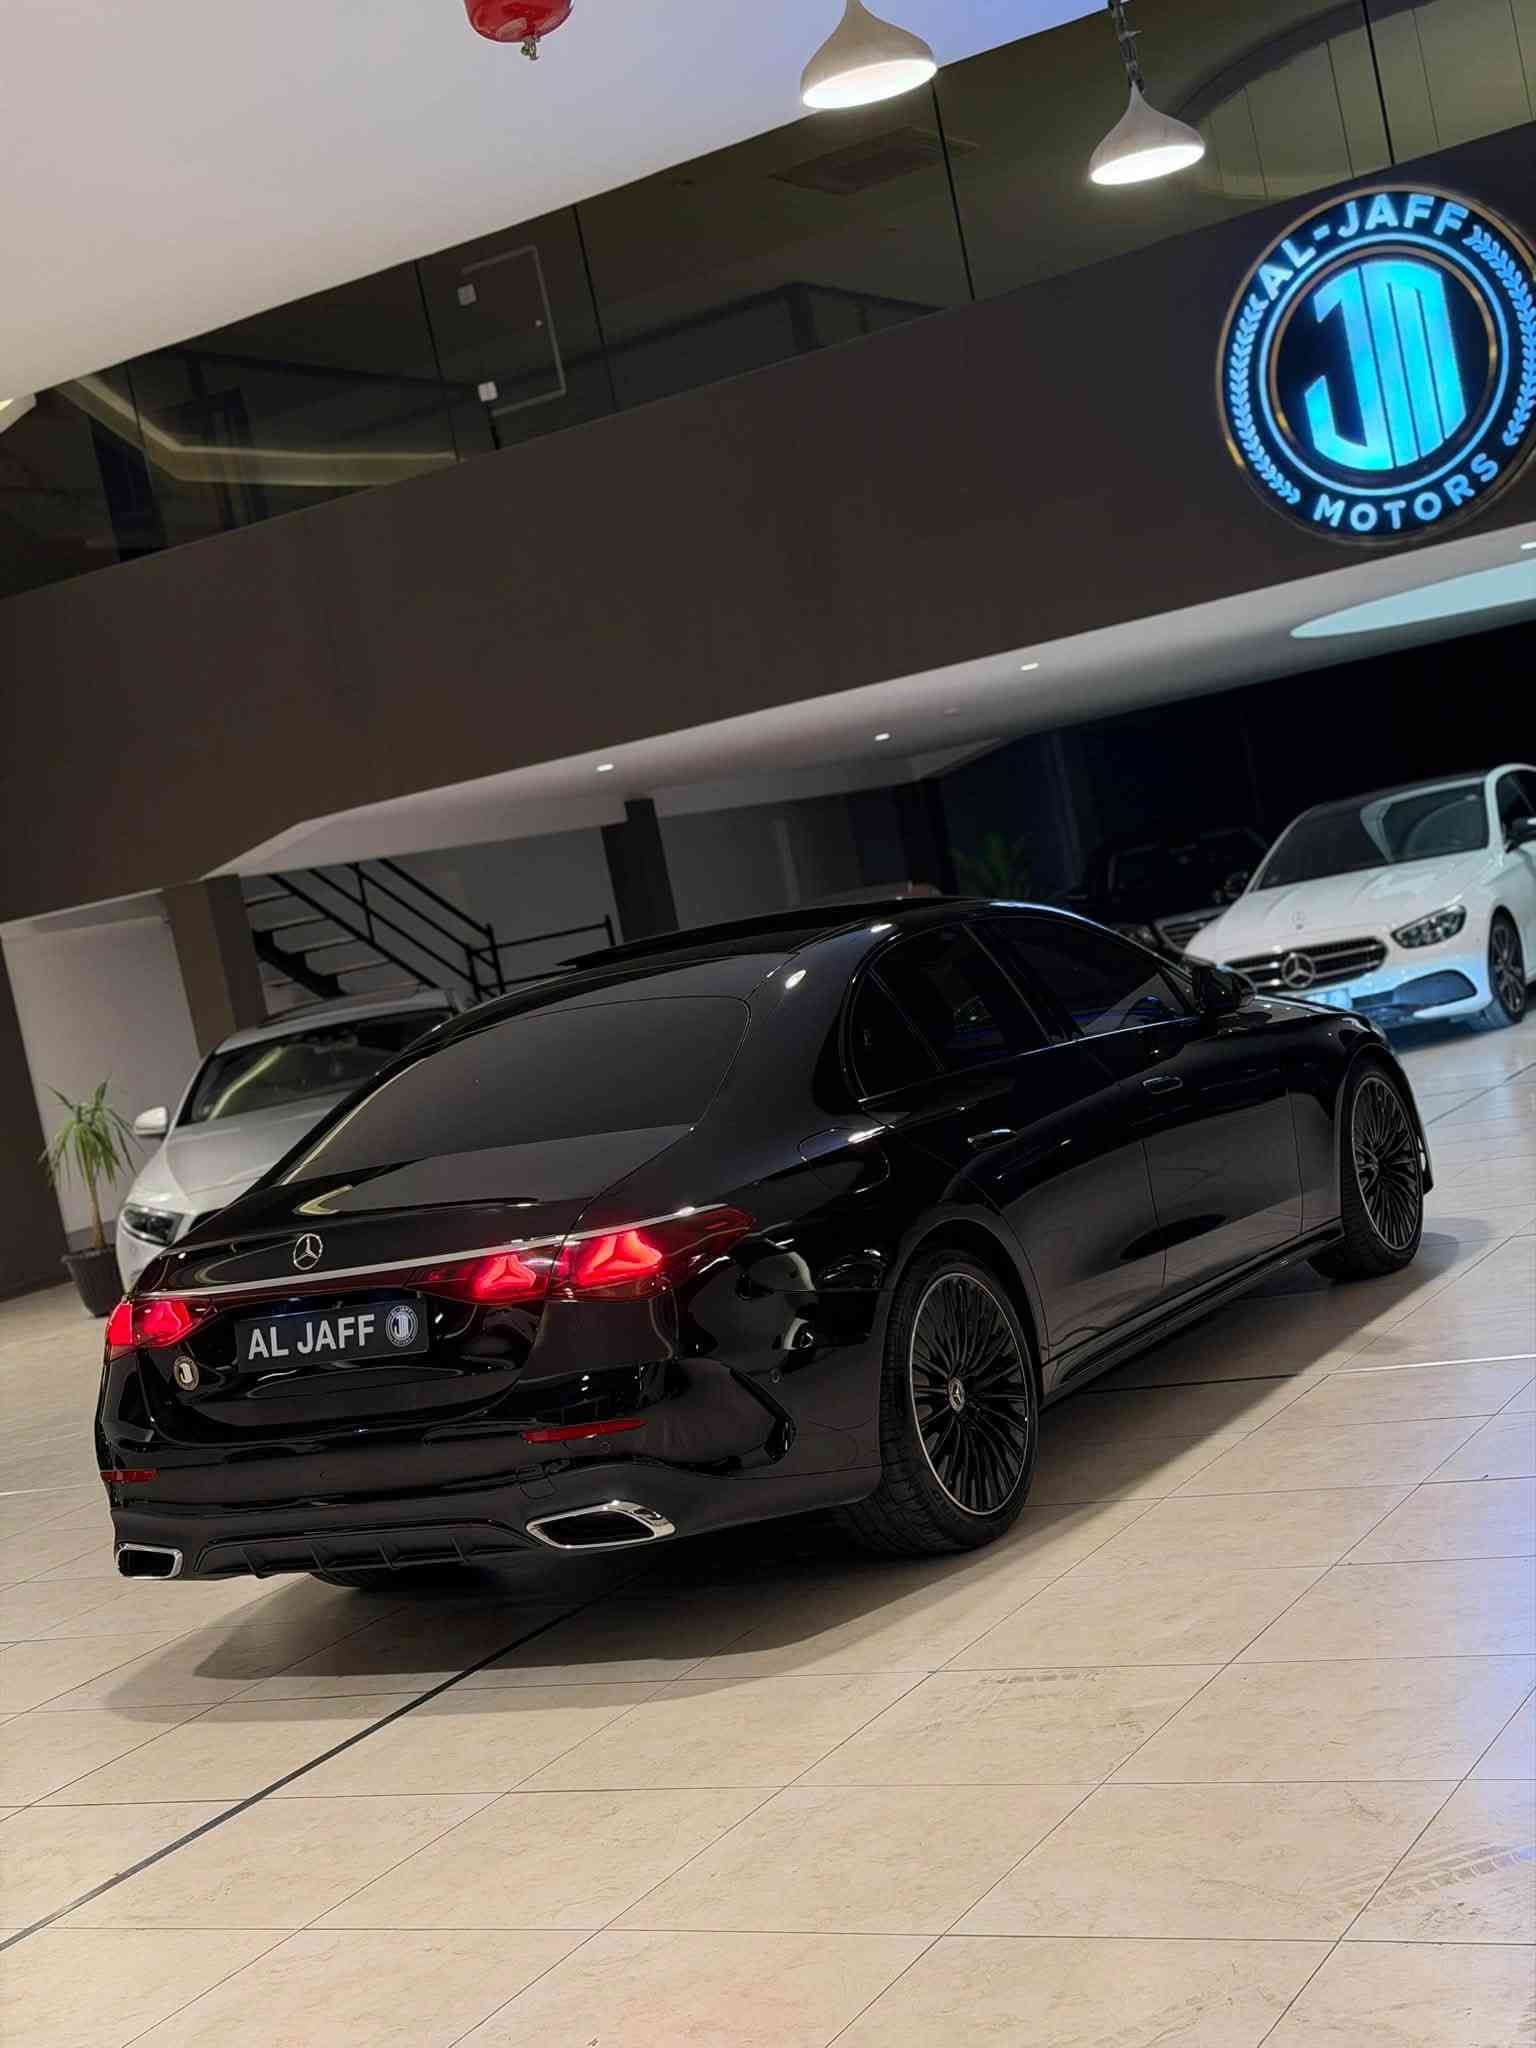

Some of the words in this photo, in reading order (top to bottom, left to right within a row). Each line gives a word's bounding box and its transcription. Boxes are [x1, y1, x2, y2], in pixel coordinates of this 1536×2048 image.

[1258, 193, 1469, 300] AL-JAFF
[1313, 452, 1499, 532] MOTORS
[247, 1326, 289, 1360] AL
[296, 1314, 375, 1354] JAFF
